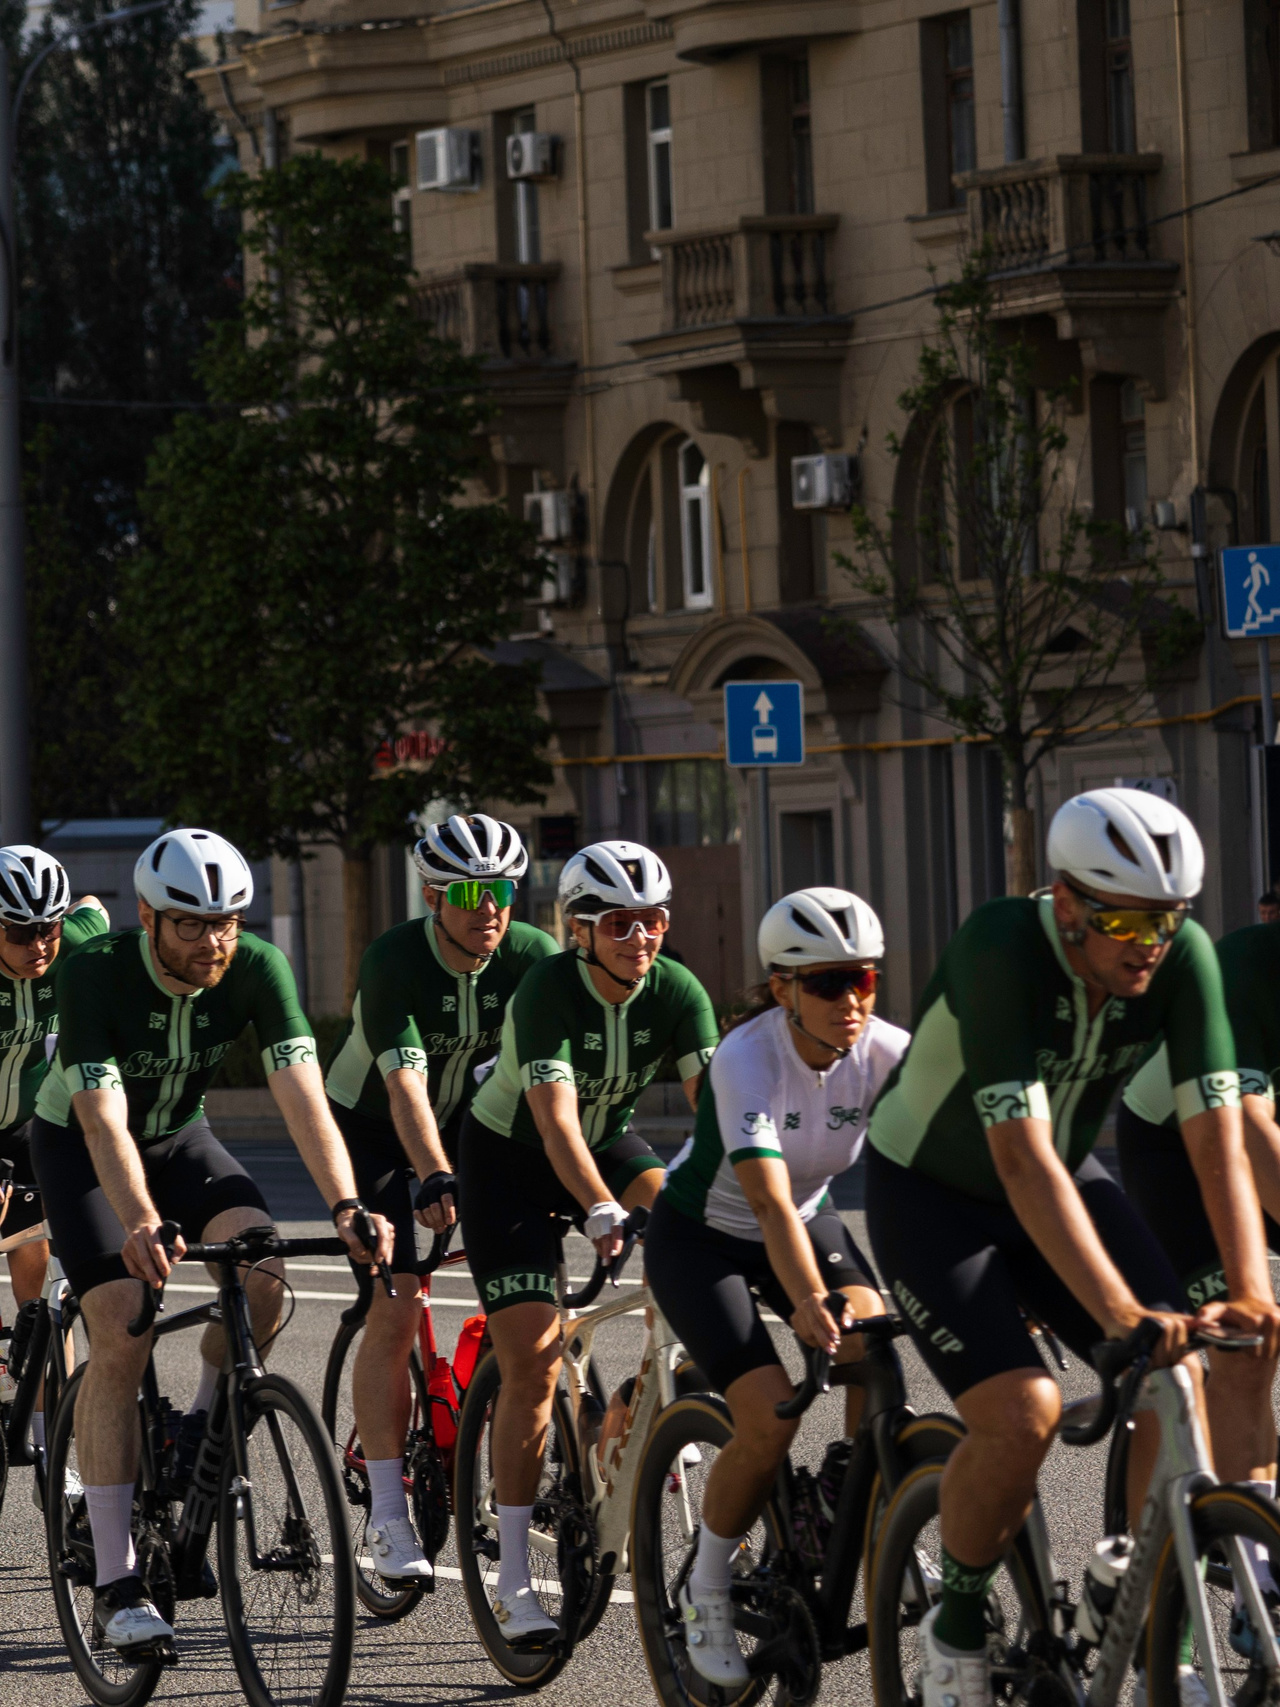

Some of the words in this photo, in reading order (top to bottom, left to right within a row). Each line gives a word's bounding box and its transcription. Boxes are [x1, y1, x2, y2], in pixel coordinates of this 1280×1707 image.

[120, 1051, 201, 1078] SKILL
[893, 1280, 931, 1329] SKILL
[930, 1327, 965, 1353] UP
